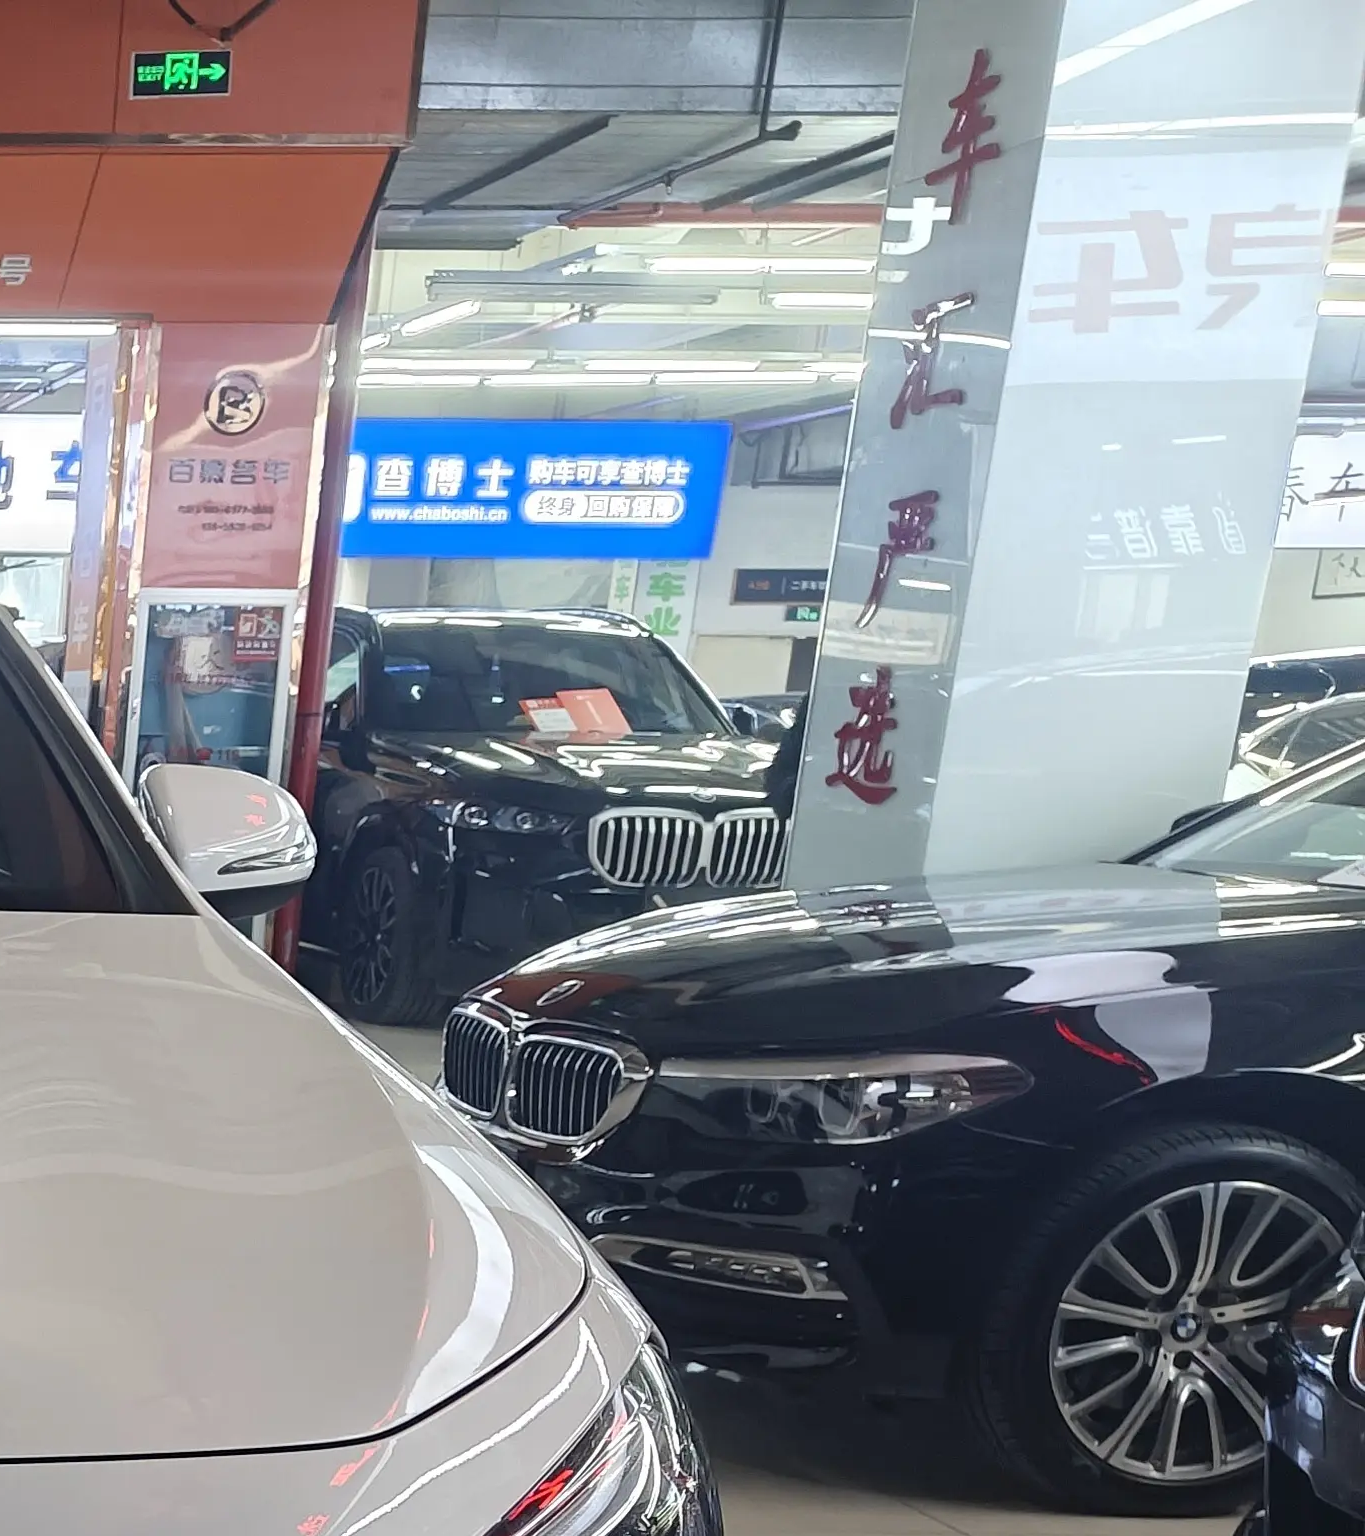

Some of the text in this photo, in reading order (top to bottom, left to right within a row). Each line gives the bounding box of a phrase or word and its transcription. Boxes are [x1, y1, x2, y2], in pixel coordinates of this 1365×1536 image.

[374, 457, 515, 500] 查博士
[371, 506, 509, 523] www.chaboshi.cn
[644, 560, 687, 636] 车业
